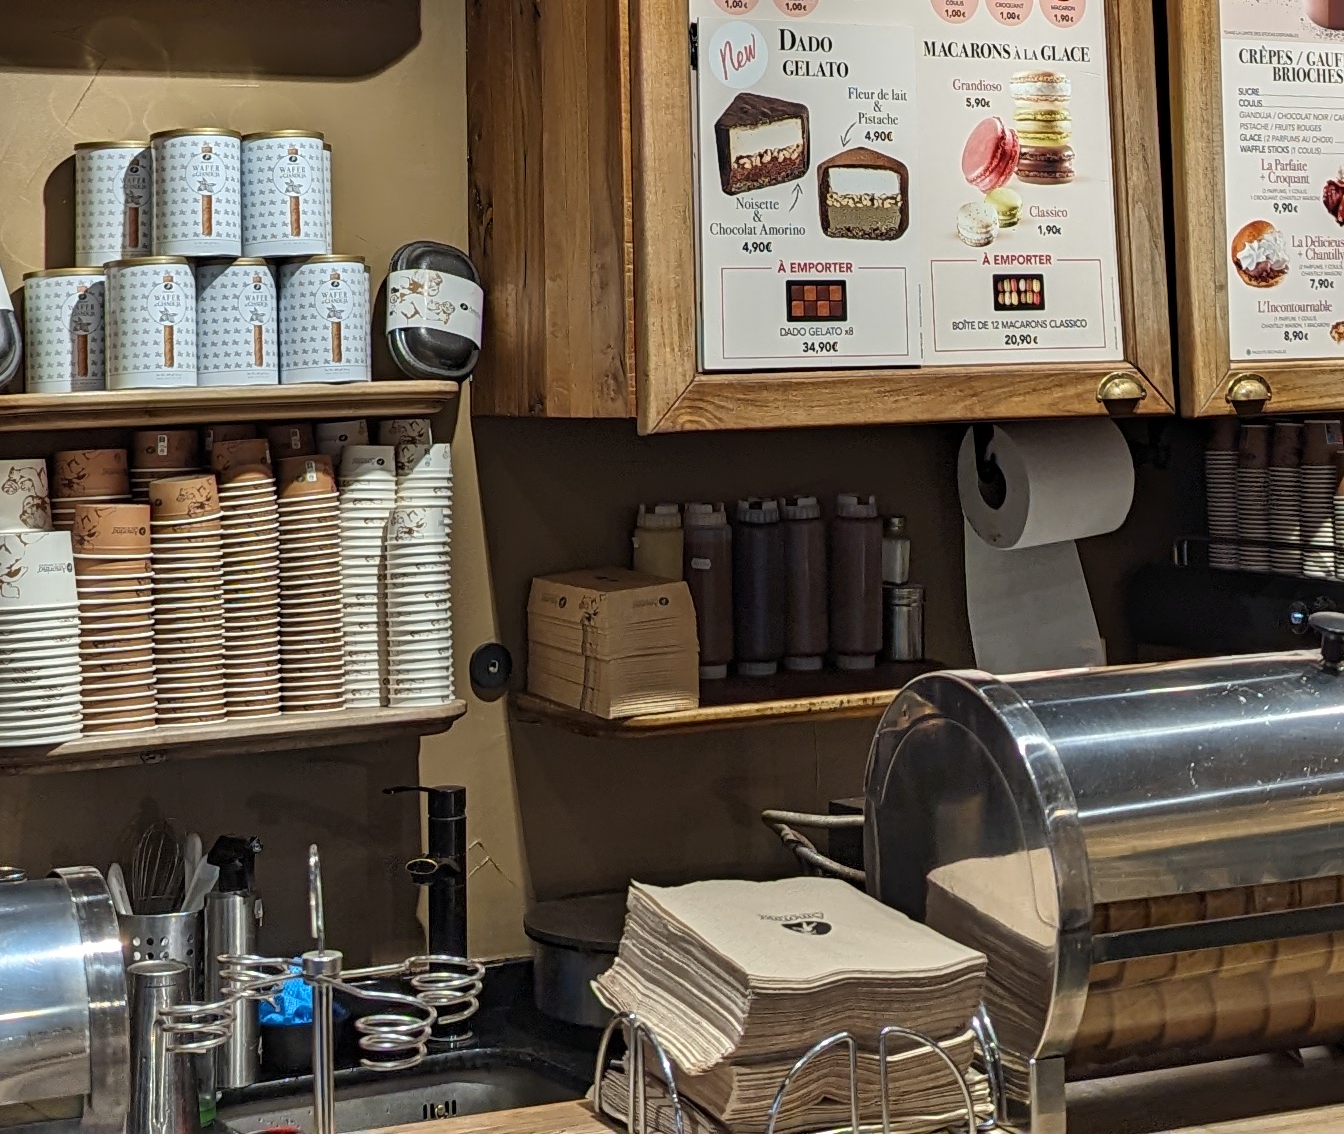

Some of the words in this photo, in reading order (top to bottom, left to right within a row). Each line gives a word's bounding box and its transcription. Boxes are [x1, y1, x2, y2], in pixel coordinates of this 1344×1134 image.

[720, 33, 756, 81] New
[923, 40, 1011, 61] MACARONS
[1013, 45, 1021, 60] À
[1024, 48, 1038, 61] LA
[1040, 45, 1091, 63] GLACE
[783, 59, 849, 78] GELATO
[952, 78, 1002, 92] Grandioso
[1238, 87, 1260, 96] SUCRE
[848, 86, 876, 100] Fleur
[877, 88, 890, 101] de
[891, 88, 907, 102] lait
[873, 101, 883, 113] &
[965, 97, 991, 109] 5,90€
[858, 112, 899, 125] Pistache
[1277, 112, 1312, 121] CHOCOLAT
[864, 131, 894, 143] 4,90€
[1240, 133, 1262, 142] GLACE
[192, 164, 220, 173] WAFER
[279, 166, 306, 175] WAFER
[1261, 158, 1273, 171] La
[1274, 158, 1307, 171] Parfaite
[119, 176, 147, 185] WAFER
[1268, 171, 1310, 187] Croquant
[735, 197, 780, 210] Noisette
[752, 210, 763, 222] &
[1029, 205, 1068, 218] Classico
[709, 222, 757, 236] Chocolat
[759, 223, 806, 236] Amorino
[1037, 225, 1062, 236] 1,90€
[742, 241, 773, 254] 4,90€
[1292, 235, 1303, 248] La
[982, 252, 991, 266] À
[993, 254, 1052, 266] EMPORTER
[1305, 247, 1344, 262] Chantilly
[777, 259, 786, 274] À
[790, 262, 853, 274] EMPORTER
[779, 327, 806, 337] DADO
[808, 326, 843, 337] GELATO
[952, 319, 976, 331] BOÎTE
[977, 321, 989, 330] DE
[991, 320, 1000, 330] 12
[1001, 320, 1048, 329] MACARONS
[1049, 319, 1087, 328] CLASSICO
[802, 341, 839, 354] 34,90€
